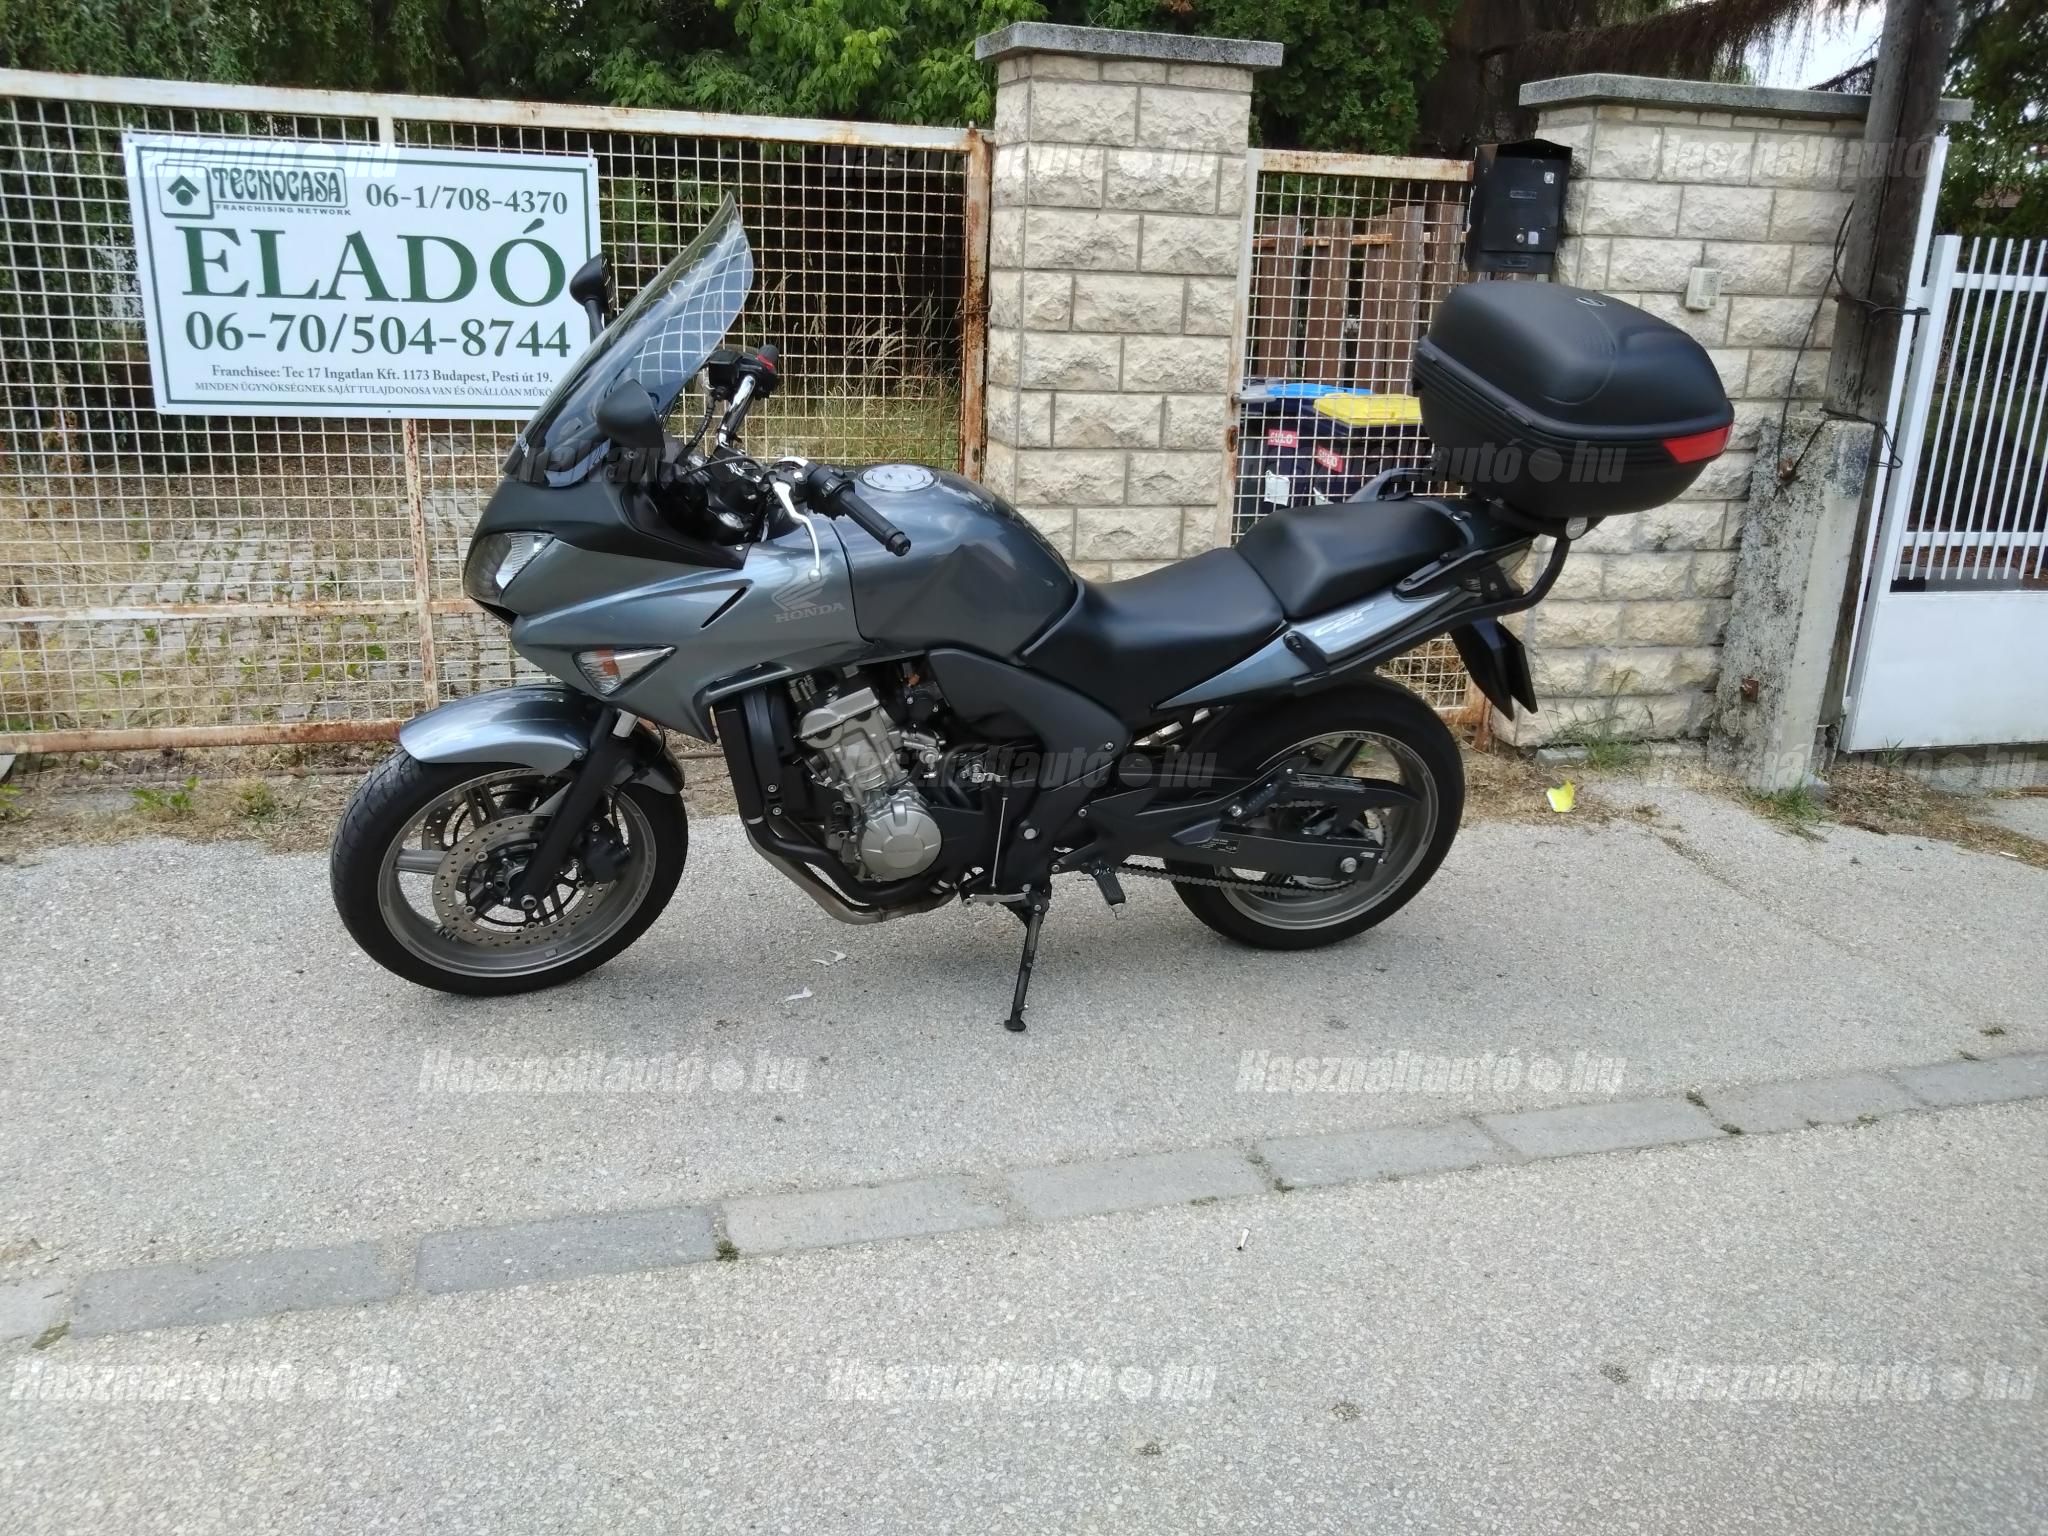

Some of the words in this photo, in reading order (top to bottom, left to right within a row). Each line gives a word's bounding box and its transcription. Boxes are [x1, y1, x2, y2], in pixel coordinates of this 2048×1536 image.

[211, 167, 342, 202] TECNOCASA
[215, 203, 294, 213] FRANCHISING
[298, 206, 352, 216] NETWORK
[366, 182, 568, 215] 06-1/708-4370
[175, 217, 567, 308] ELADÓ
[185, 310, 571, 359] 06-70/504-8744
[211, 364, 280, 378] Franchisee:
[282, 365, 305, 378] Tec
[308, 367, 321, 379] 17
[324, 367, 374, 382] Ingatlan
[376, 368, 400, 380] Kft.
[403, 369, 430, 381] 1173
[433, 369, 490, 385] Budapest,
[492, 370, 520, 382] Pesti
[522, 371, 534, 383] út
[536, 371, 553, 383] 19.
[194, 382, 239, 392] MINDEN
[327, 383, 358, 396] SAJÁT
[358, 385, 432, 396] TULAJDONOSA
[433, 386, 452, 396] VAN
[454, 386, 466, 396] ÉS
[773, 602, 846, 624] HONDA
